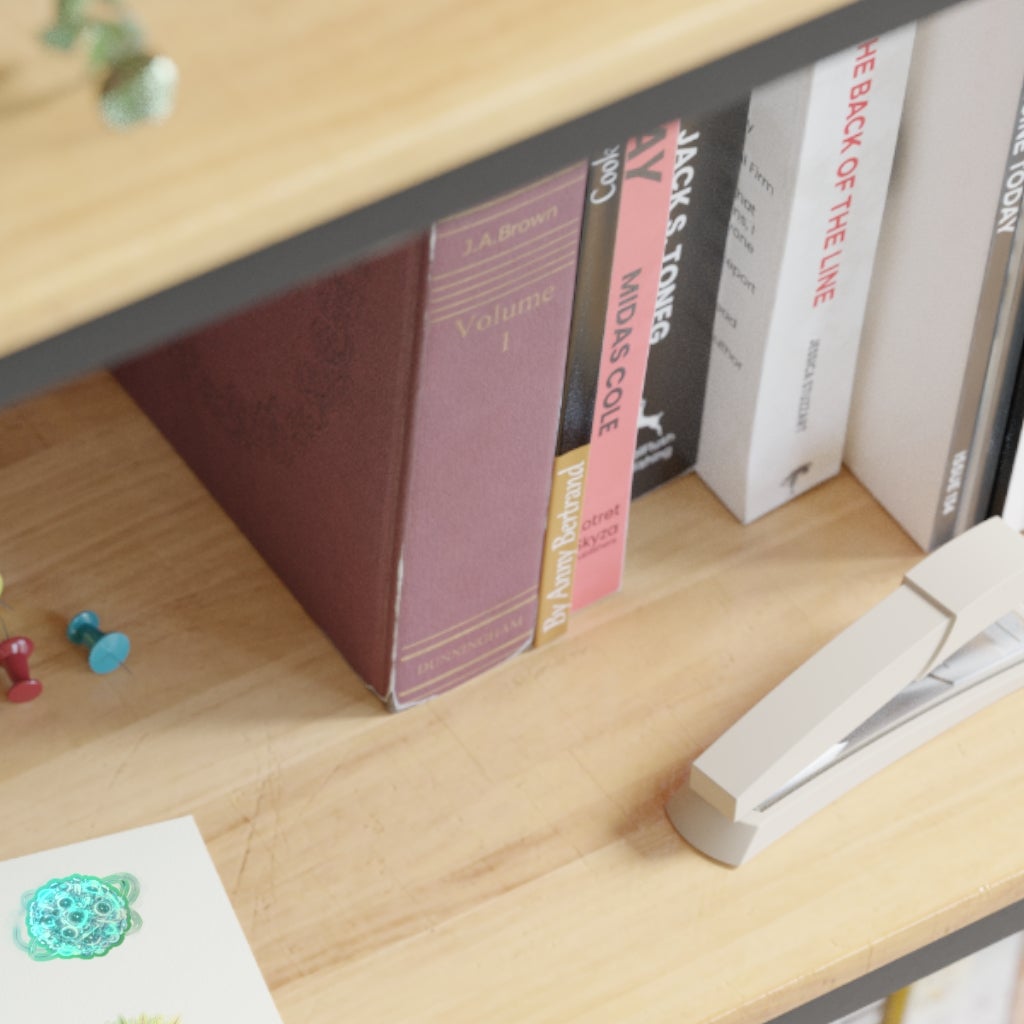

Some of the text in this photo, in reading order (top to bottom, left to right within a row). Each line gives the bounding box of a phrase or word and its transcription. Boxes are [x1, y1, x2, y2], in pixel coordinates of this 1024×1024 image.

[840, 79, 872, 154] BACK
[590, 144, 620, 204] Cook
[669, 129, 700, 211] JACK
[834, 156, 859, 191] OF
[997, 160, 1024, 234] TODAY
[823, 194, 852, 250] THE
[812, 250, 843, 308] LINE
[456, 285, 556, 338] Volume
[598, 267, 642, 437] MIDAS COLE
[551, 460, 585, 551] Bertrand
[543, 603, 571, 633] By
